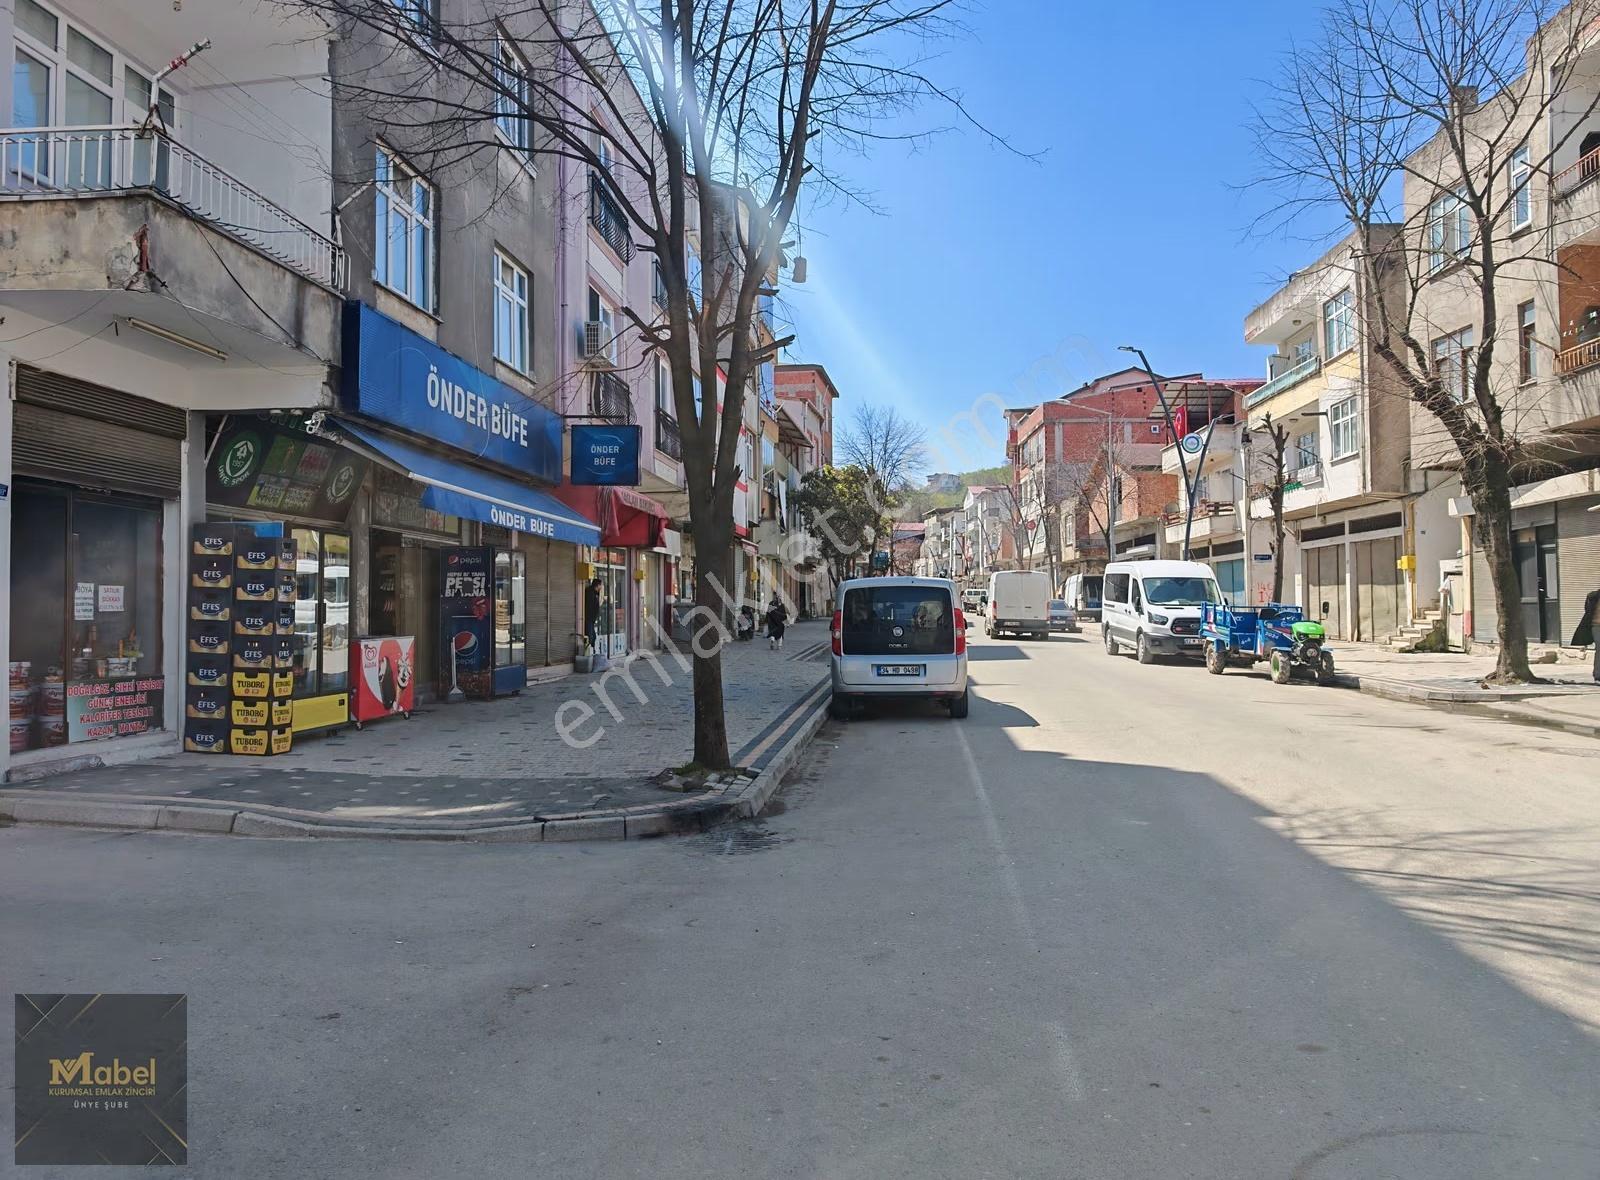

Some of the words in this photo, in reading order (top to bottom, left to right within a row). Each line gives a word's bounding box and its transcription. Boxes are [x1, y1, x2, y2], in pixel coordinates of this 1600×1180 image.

[427, 364, 487, 430] ÖNDER
[491, 402, 528, 447] BÜFE
[590, 444, 620, 454] ÖNDER
[594, 456, 616, 466] BÜFE
[490, 504, 526, 530] ÖNDER
[530, 517, 554, 537] BÜFE
[204, 537, 223, 545] EFES
[247, 551, 266, 560] EFES
[203, 570, 222, 578] EFES
[246, 583, 265, 591] EFES
[201, 602, 220, 611] EFES
[245, 617, 264, 626] EFES
[200, 635, 219, 644] EFES
[244, 650, 263, 659] EFES
[199, 668, 218, 677] EFES
[237, 680, 265, 689] TUBORG
[197, 700, 216, 709] EFES
[236, 709, 264, 717] TUBORG
[196, 733, 214, 742] EFES
[235, 737, 263, 746] TUBORG
